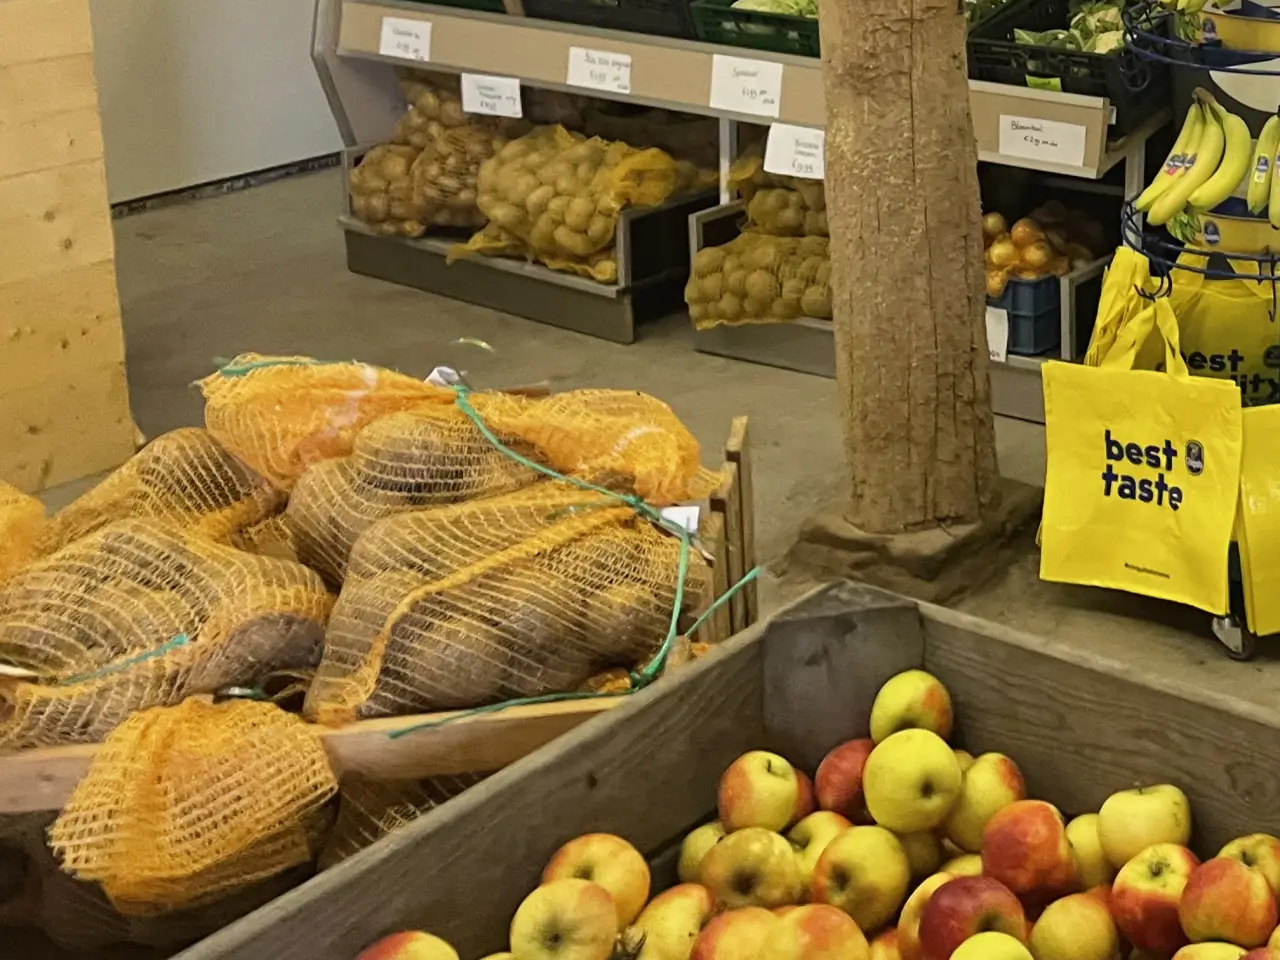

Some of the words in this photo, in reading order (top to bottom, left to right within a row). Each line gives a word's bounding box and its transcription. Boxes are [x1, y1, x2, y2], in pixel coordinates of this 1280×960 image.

[1180, 349, 1245, 373] est
[1105, 429, 1178, 472] best
[1101, 464, 1183, 512] taste
